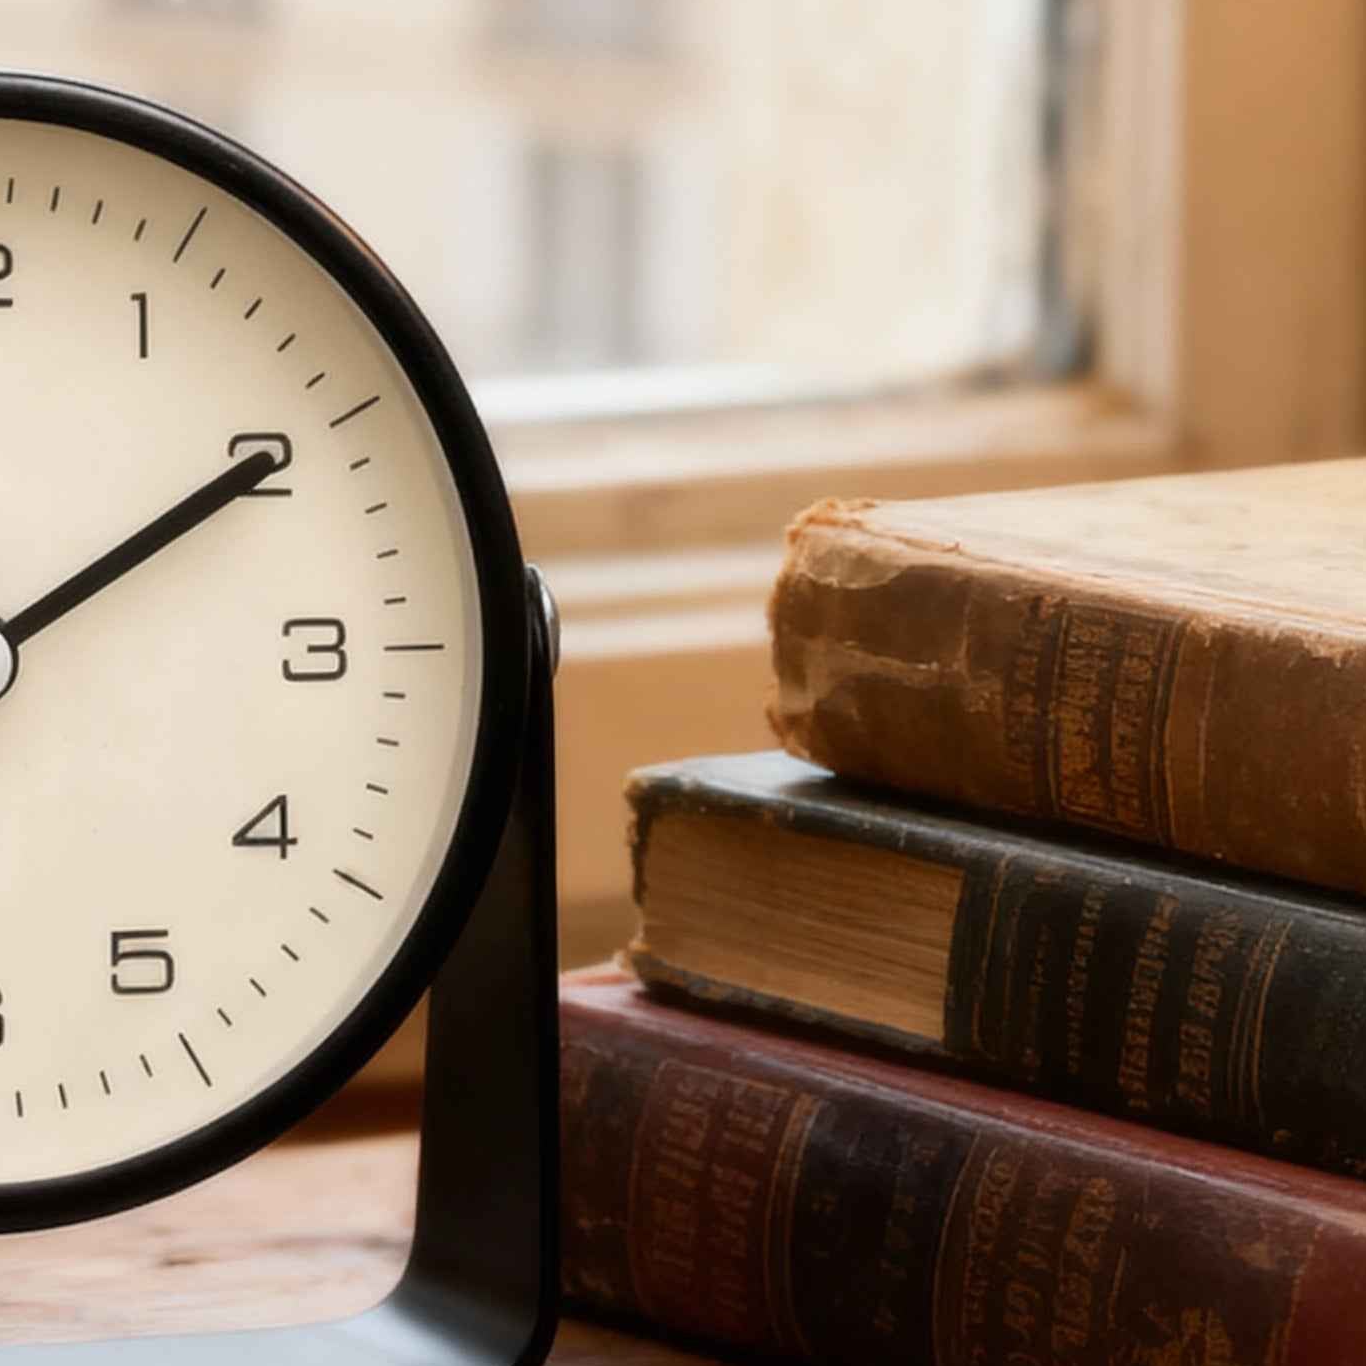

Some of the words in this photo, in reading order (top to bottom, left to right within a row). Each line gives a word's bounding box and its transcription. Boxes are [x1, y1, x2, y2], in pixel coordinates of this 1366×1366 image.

[130, 292, 148, 359] 1
[228, 432, 292, 497] 2
[282, 618, 348, 683] 3
[231, 794, 299, 860] 4
[111, 929, 175, 996] 5
